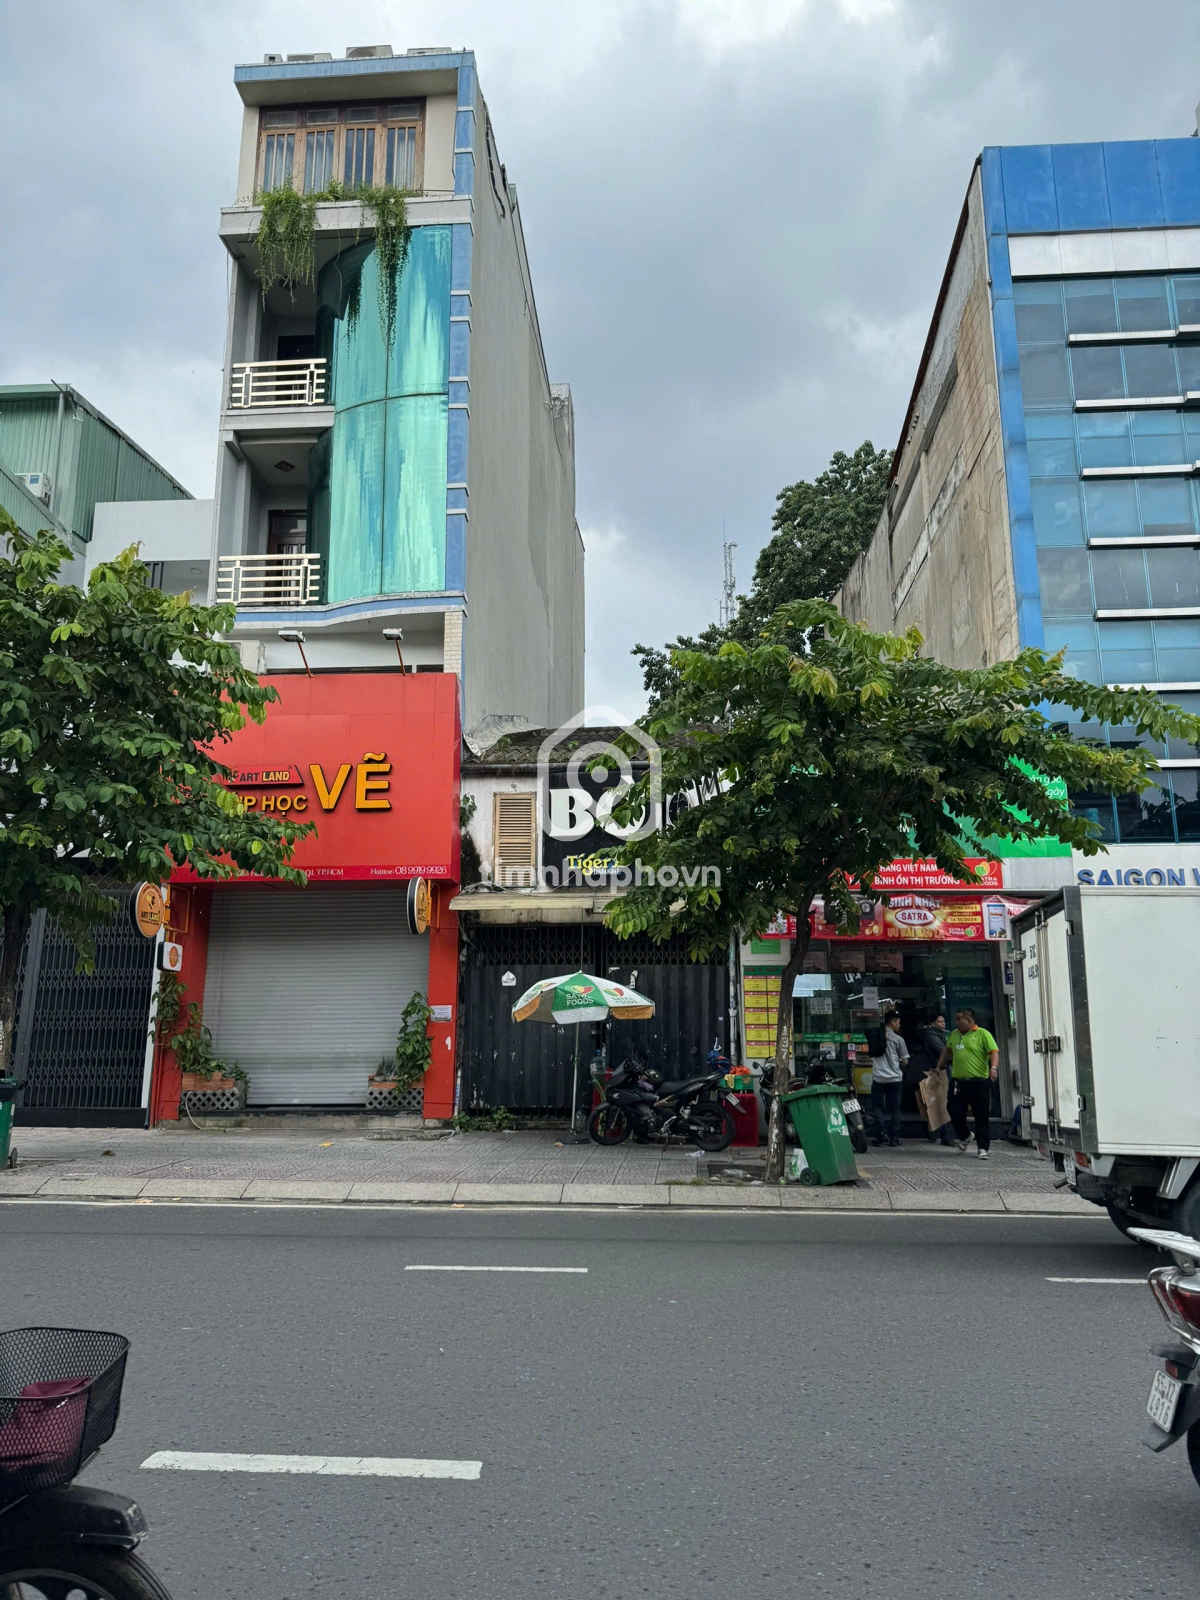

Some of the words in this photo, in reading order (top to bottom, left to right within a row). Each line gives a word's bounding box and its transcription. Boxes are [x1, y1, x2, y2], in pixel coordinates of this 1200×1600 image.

[240, 772, 260, 782] ART
[262, 770, 291, 783] LAND
[309, 752, 392, 810] VẼ
[262, 795, 308, 816] HỌC
[566, 853, 612, 876] Tiger
[902, 862, 919, 874] VIỆT
[920, 863, 938, 872] NAM
[910, 876, 924, 887] THỊ
[1077, 868, 1186, 886] SAIGON
[901, 912, 928, 921] SATRA
